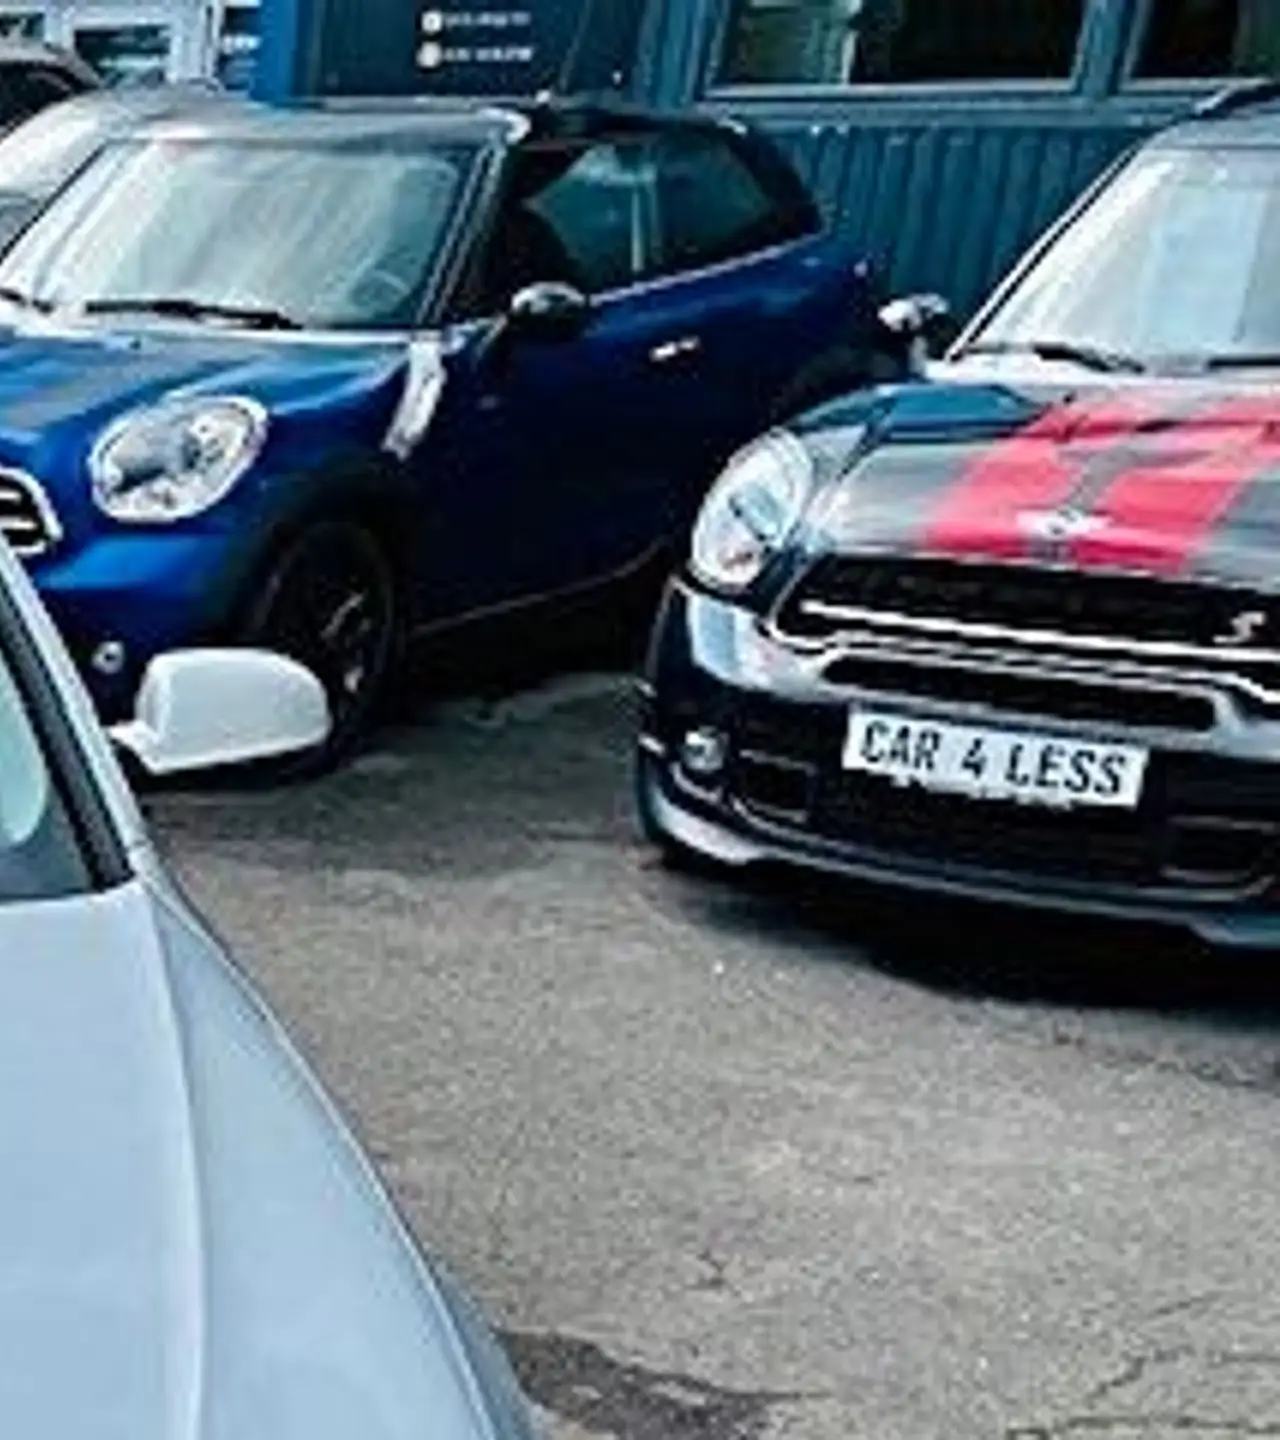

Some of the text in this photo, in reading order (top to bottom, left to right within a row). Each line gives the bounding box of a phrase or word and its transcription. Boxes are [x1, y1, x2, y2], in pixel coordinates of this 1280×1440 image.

[861, 720, 1126, 796] CAR 4 LESS
